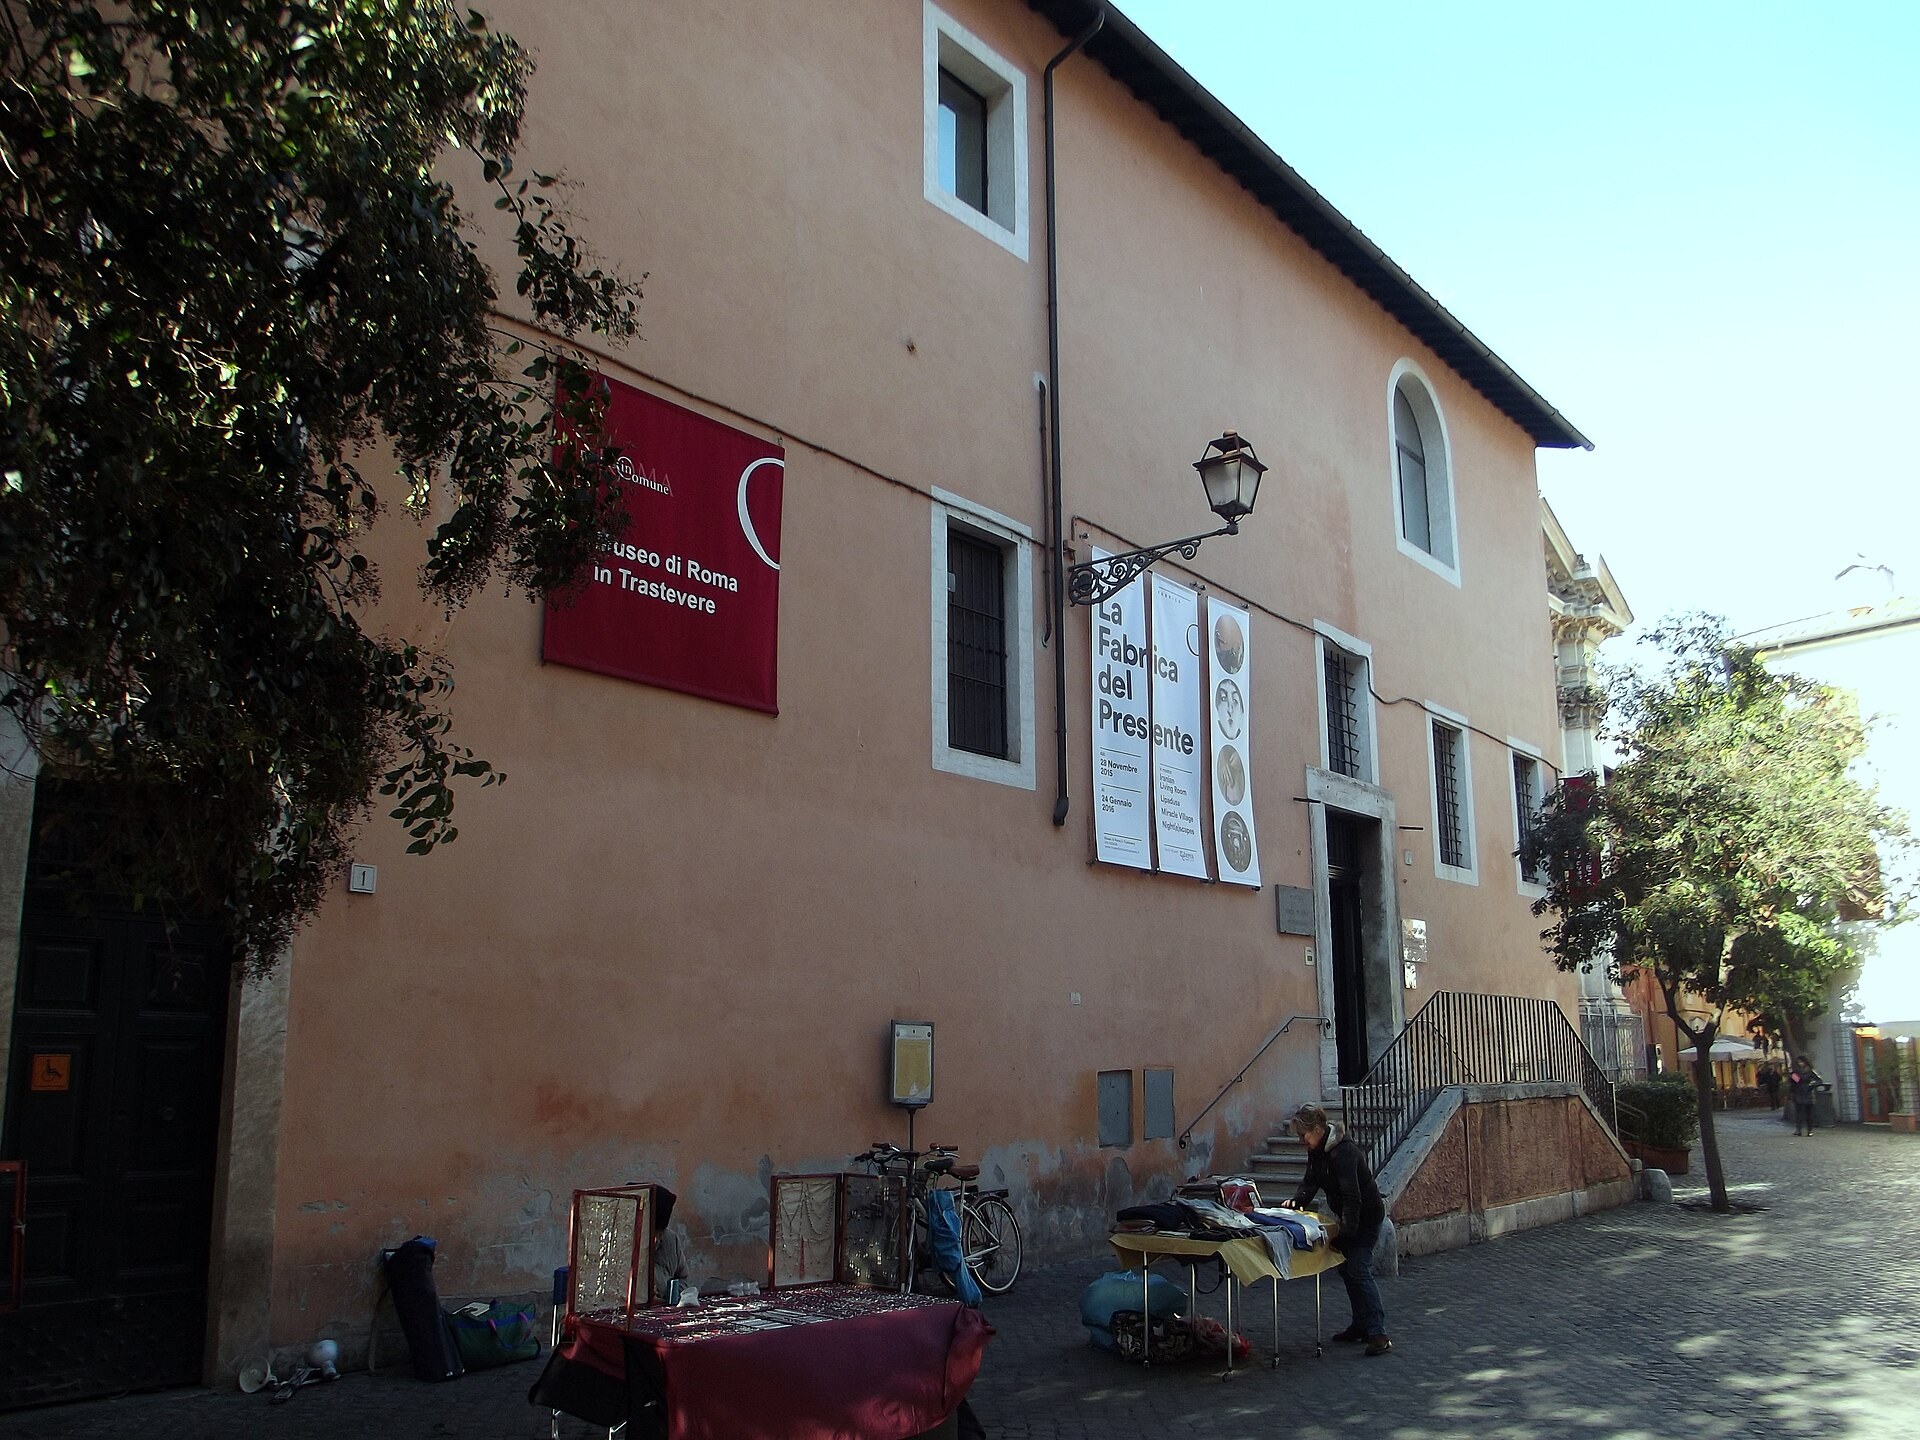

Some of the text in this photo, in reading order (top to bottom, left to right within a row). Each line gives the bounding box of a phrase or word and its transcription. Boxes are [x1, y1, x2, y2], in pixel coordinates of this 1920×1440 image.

[597, 531, 738, 593] useo di Roma
[594, 561, 717, 614] in Trastevere
[1098, 601, 1123, 626] La
[1098, 624, 1179, 684] Fabrica
[1098, 664, 1133, 700] del
[1098, 698, 1195, 756] Presente
[1100, 767, 1114, 777] 2015
[1107, 759, 1138, 774] Novembre
[1109, 795, 1133, 808] Gennaio
